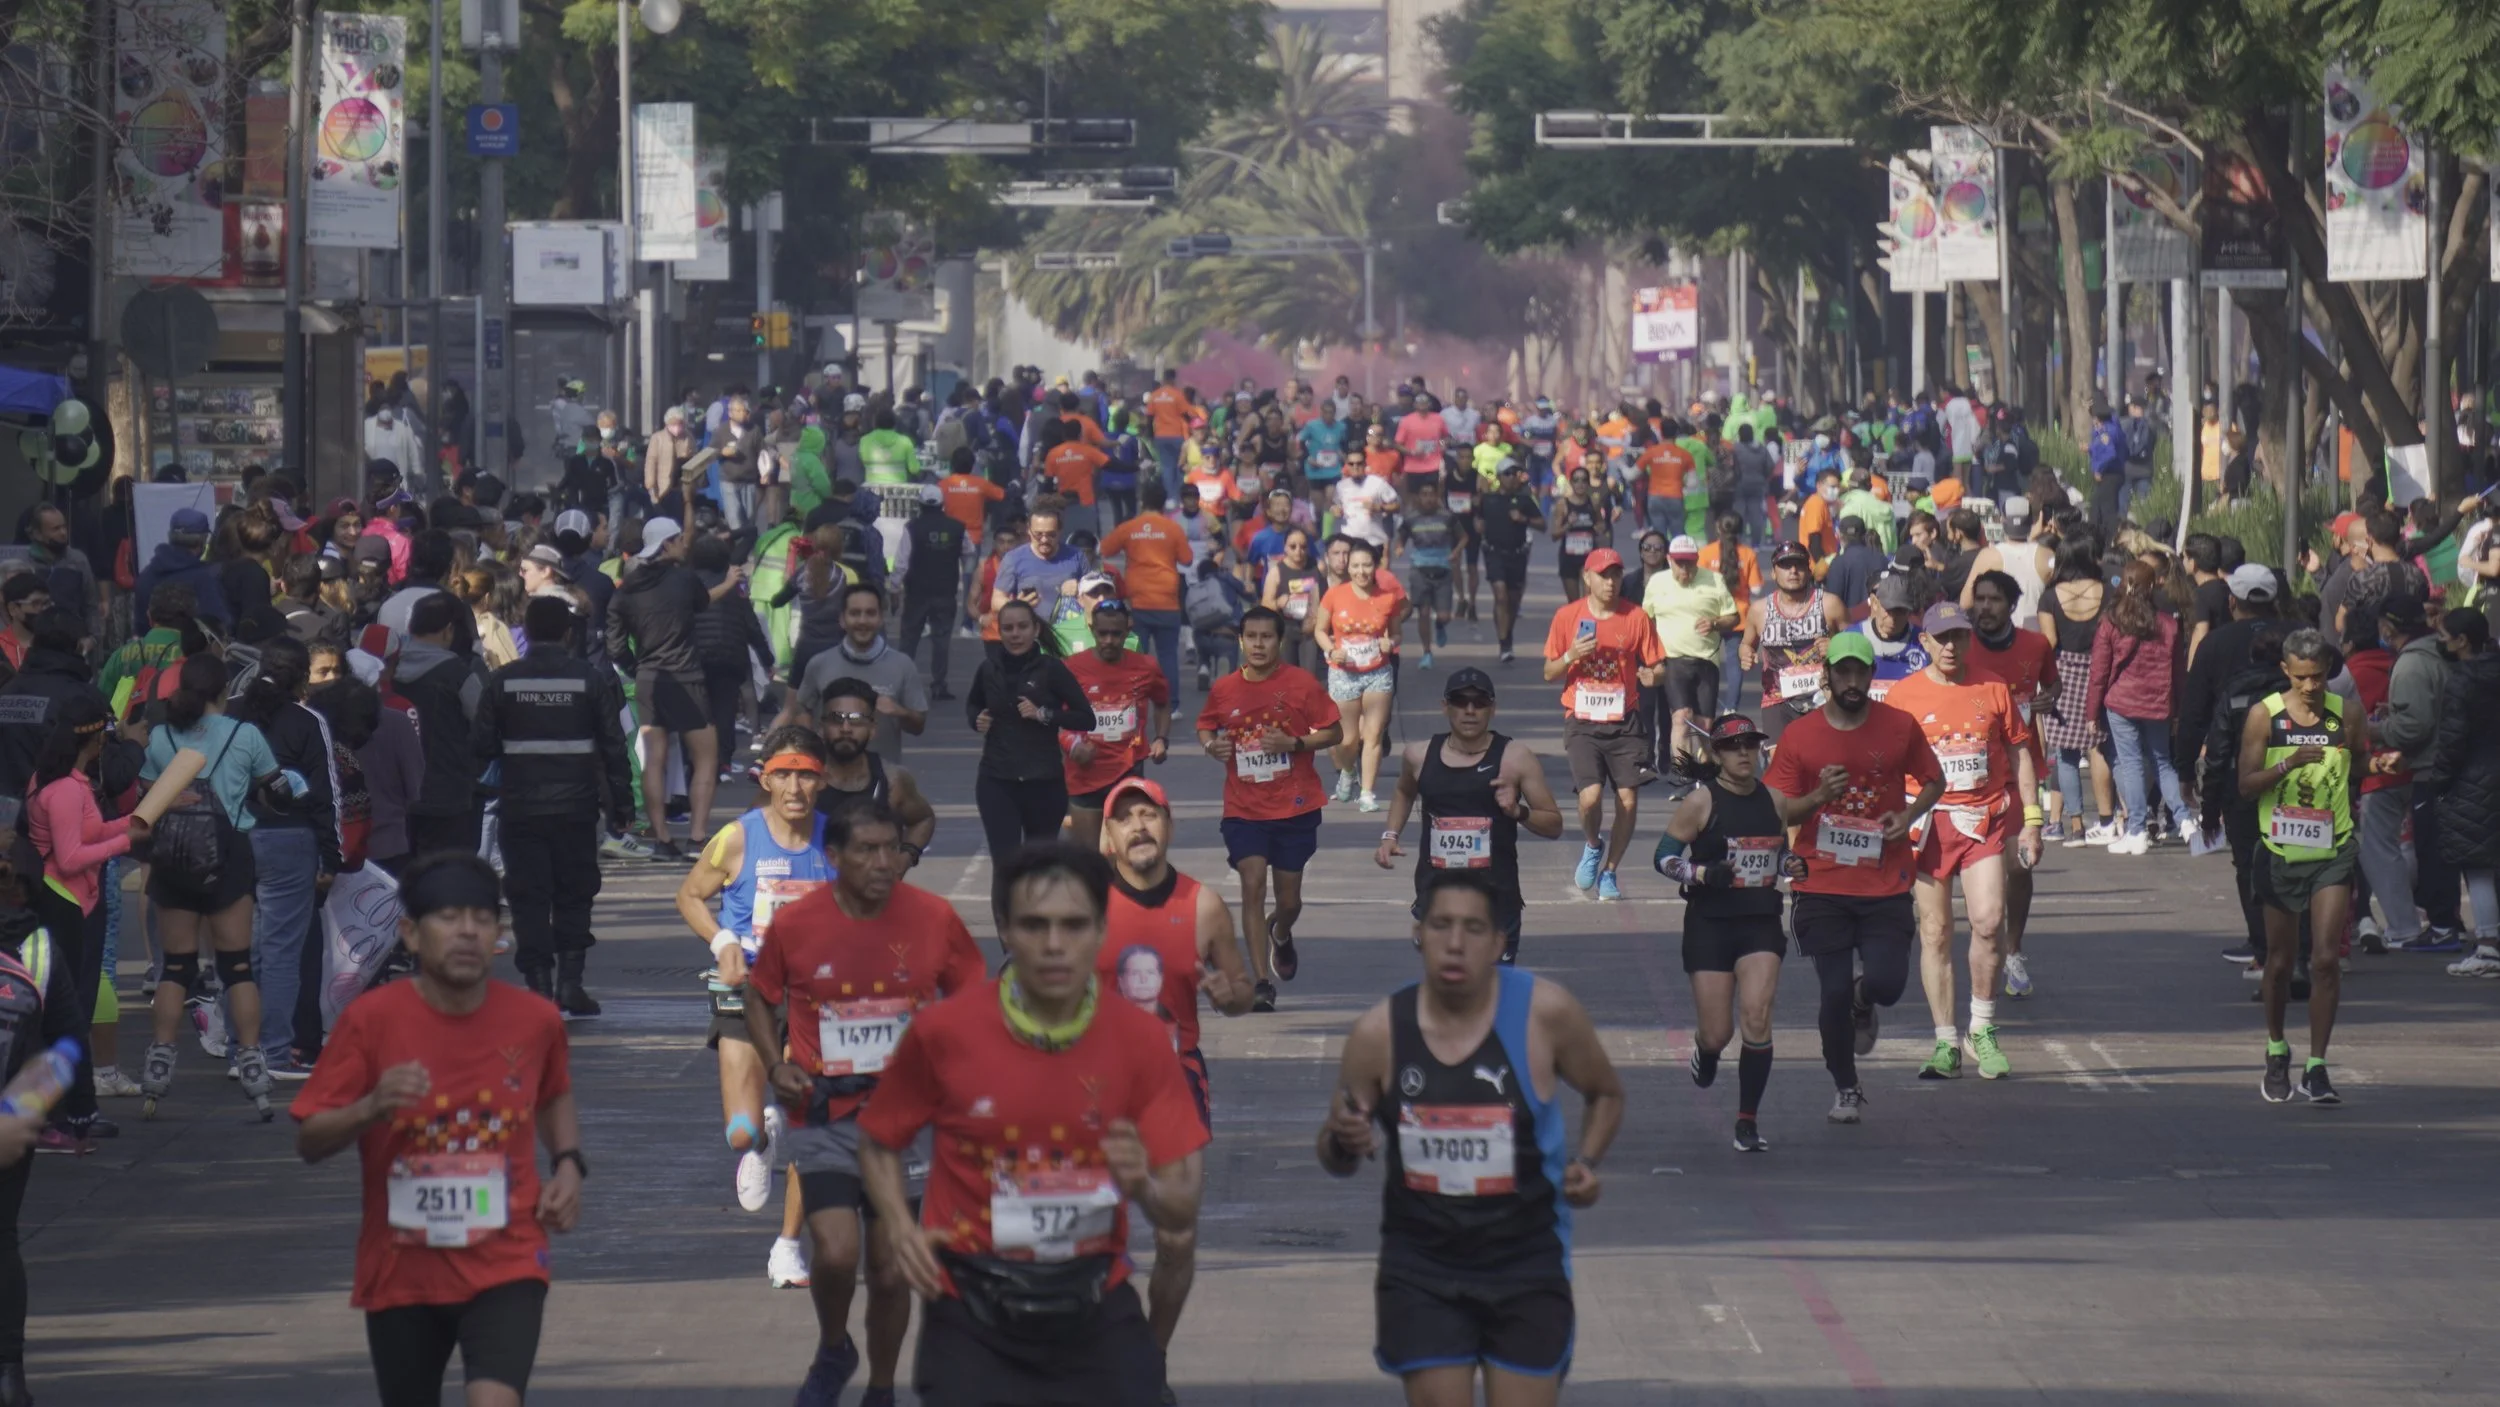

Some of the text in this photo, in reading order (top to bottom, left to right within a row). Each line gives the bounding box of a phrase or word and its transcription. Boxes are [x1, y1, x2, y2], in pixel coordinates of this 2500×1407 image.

[1585, 695, 1614, 707] 10719
[1098, 713, 1124, 727] 8095
[2286, 734, 2329, 745] MEXICO
[1245, 752, 1278, 768] 14733
[1943, 758, 1979, 773] 17855
[2281, 822, 2321, 838] 11765
[1440, 835, 1473, 849] 4943
[1829, 831, 1869, 848] 13463
[1741, 854, 1769, 869] 4938
[838, 1023, 892, 1047] 14971
[1420, 1138, 1488, 1162] 17003
[416, 1186, 472, 1212] 2511
[1032, 1205, 1078, 1236] 572
